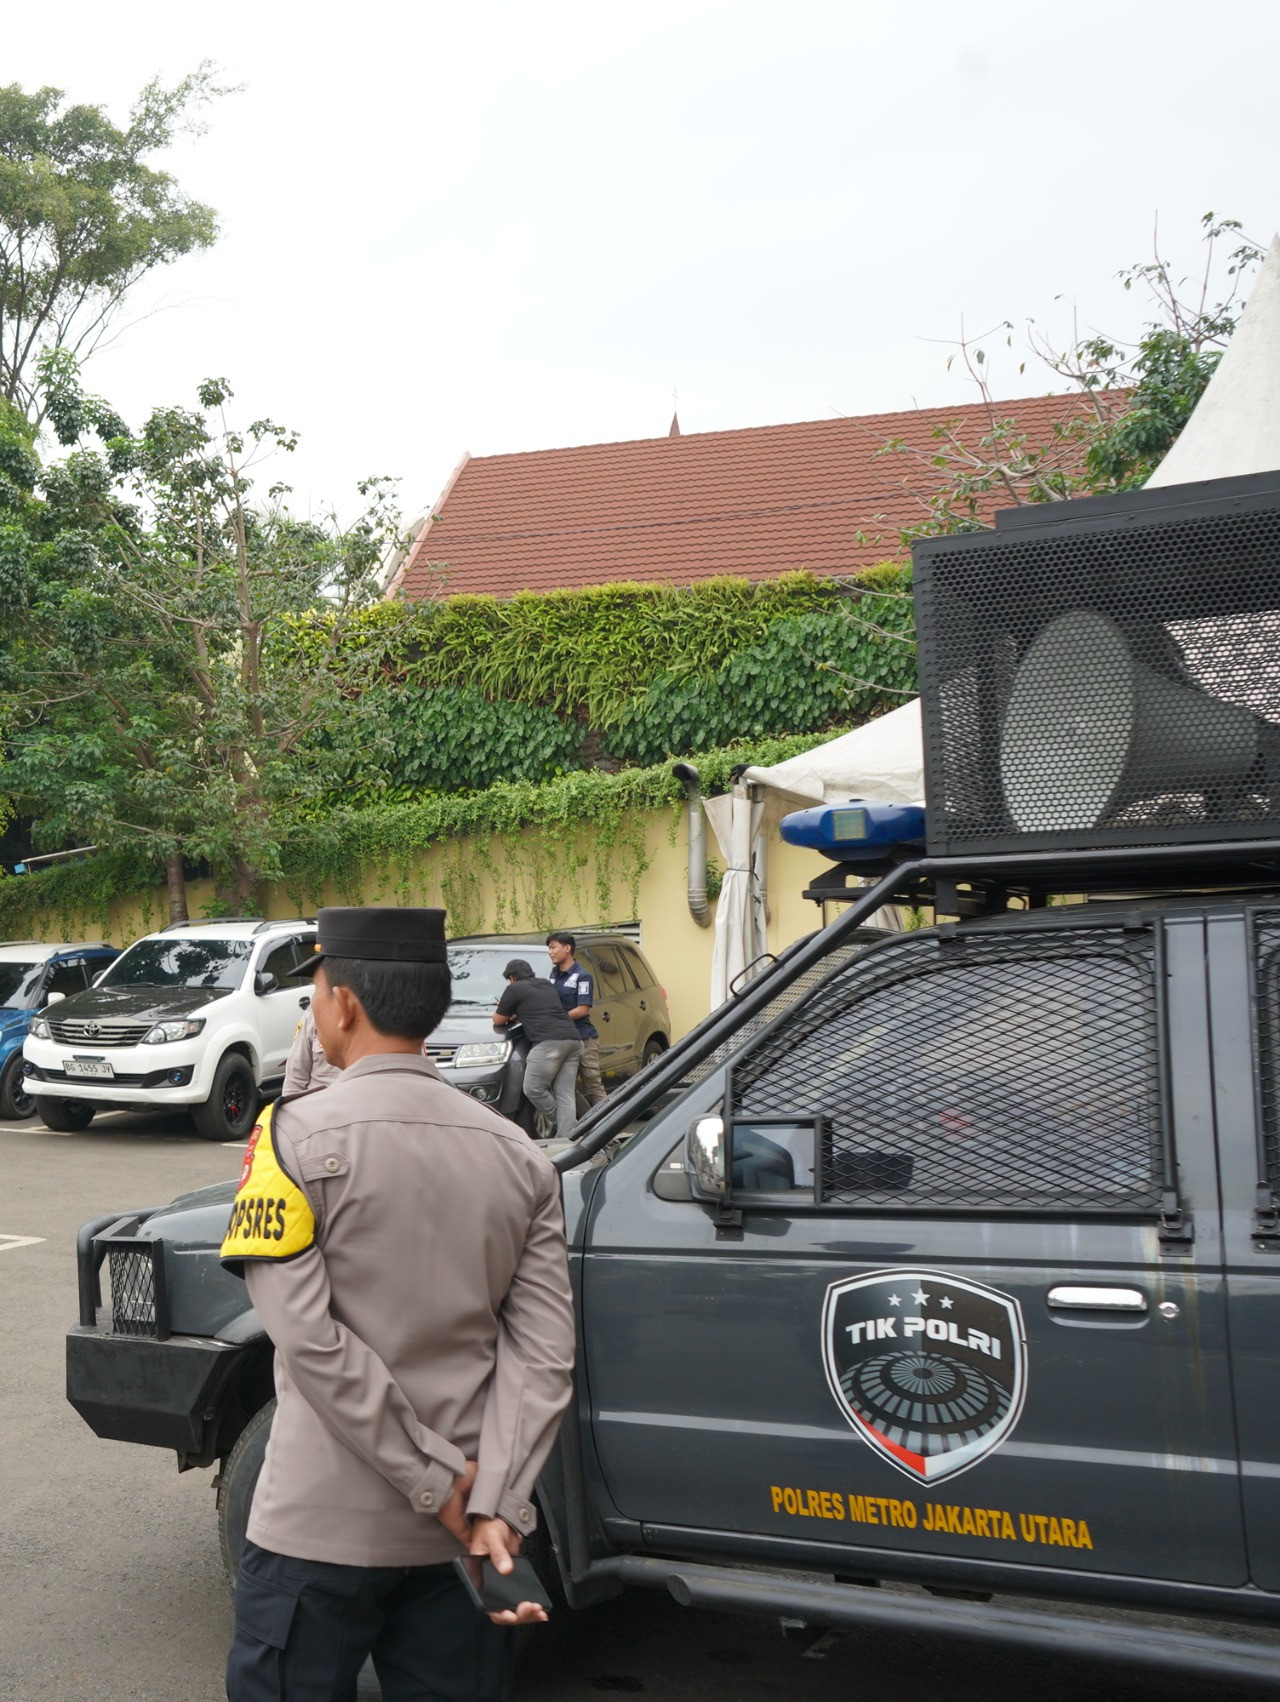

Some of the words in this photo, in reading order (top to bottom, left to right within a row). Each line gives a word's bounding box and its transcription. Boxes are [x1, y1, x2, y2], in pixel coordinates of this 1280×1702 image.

[78, 1064, 98, 1073] 1455
[845, 1316, 897, 1345] TIK
[903, 1315, 1002, 1360] POLRI
[770, 1486, 846, 1521] POLRES
[848, 1493, 918, 1529] METRO
[922, 1503, 1017, 1541] JAKARTA
[1019, 1512, 1094, 1551] UTARA
